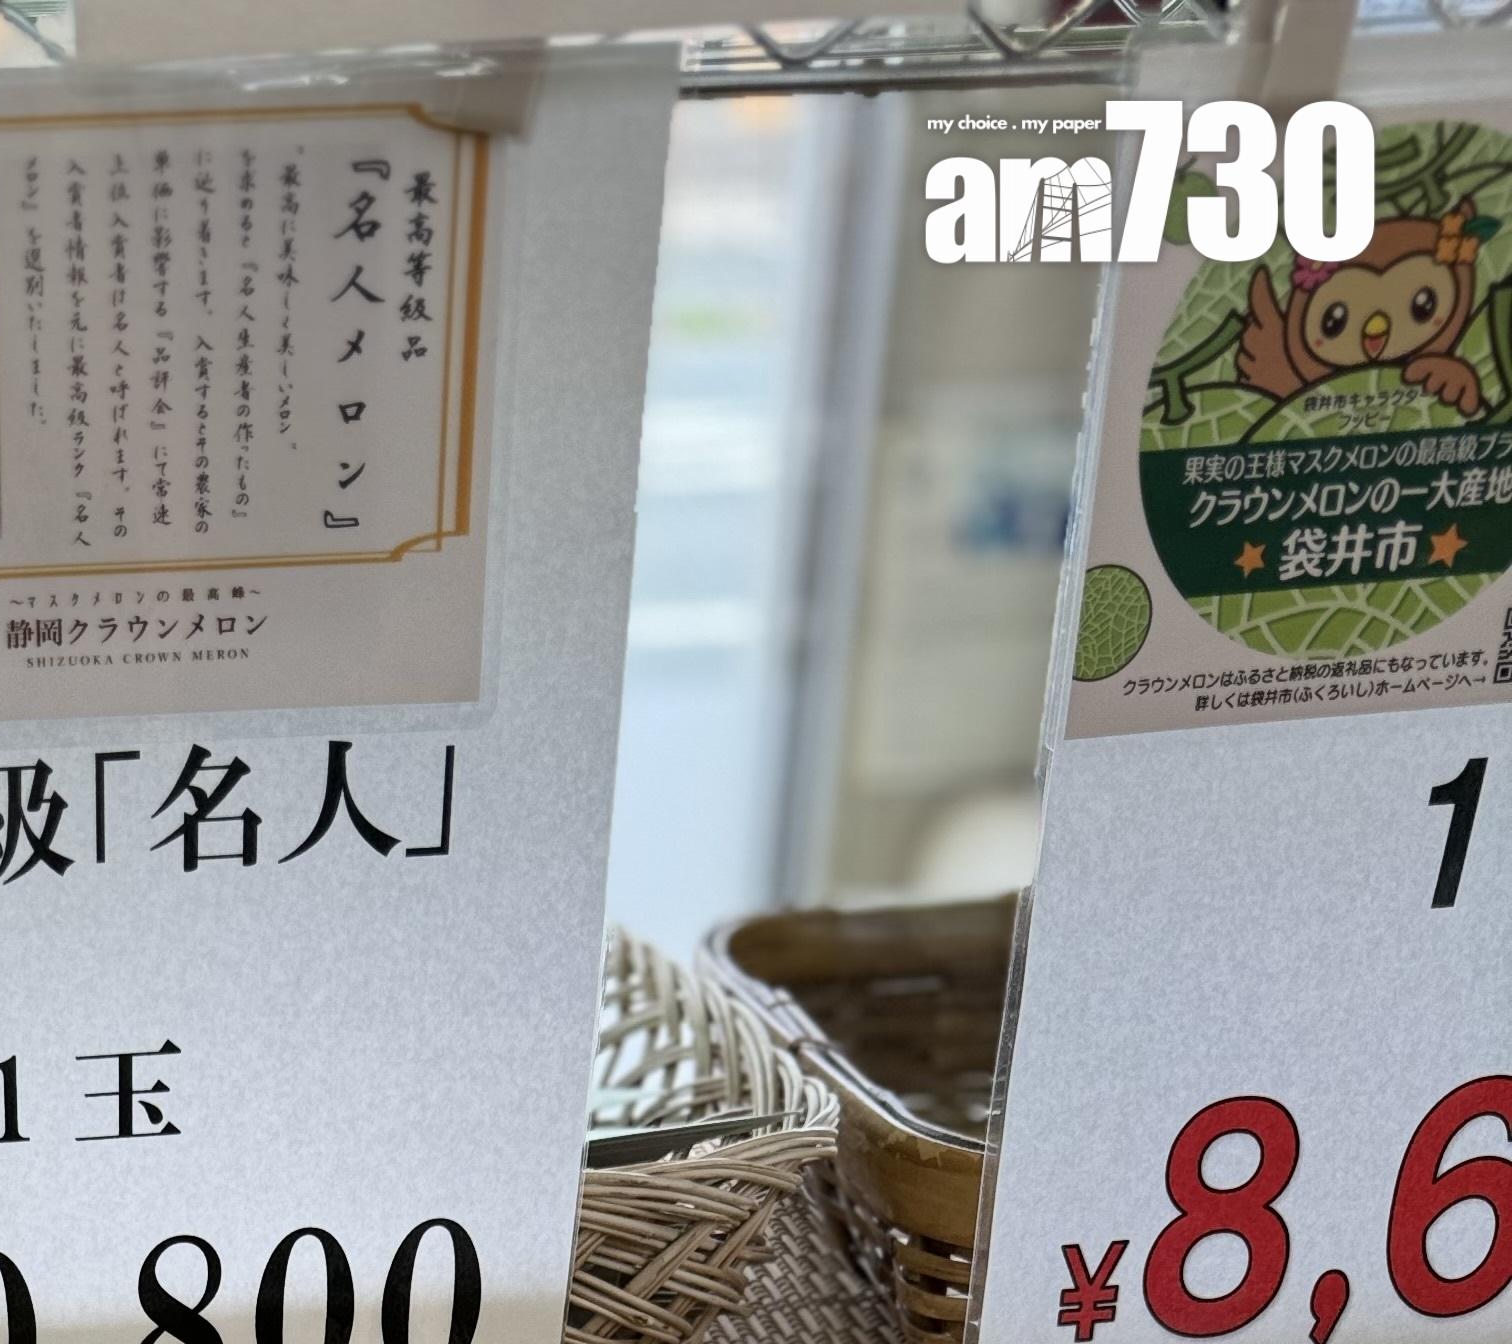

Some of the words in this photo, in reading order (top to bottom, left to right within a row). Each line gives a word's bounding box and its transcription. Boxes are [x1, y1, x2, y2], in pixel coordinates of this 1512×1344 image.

[400, 171, 438, 361] 最高等級品
[1279, 519, 1424, 582] 袋井市
[6, 613, 269, 650] 静岡クラウンメロン
[26, 655, 114, 669] SHIZUOKA
[122, 651, 183, 665] CROWN
[191, 647, 251, 662] MERON
